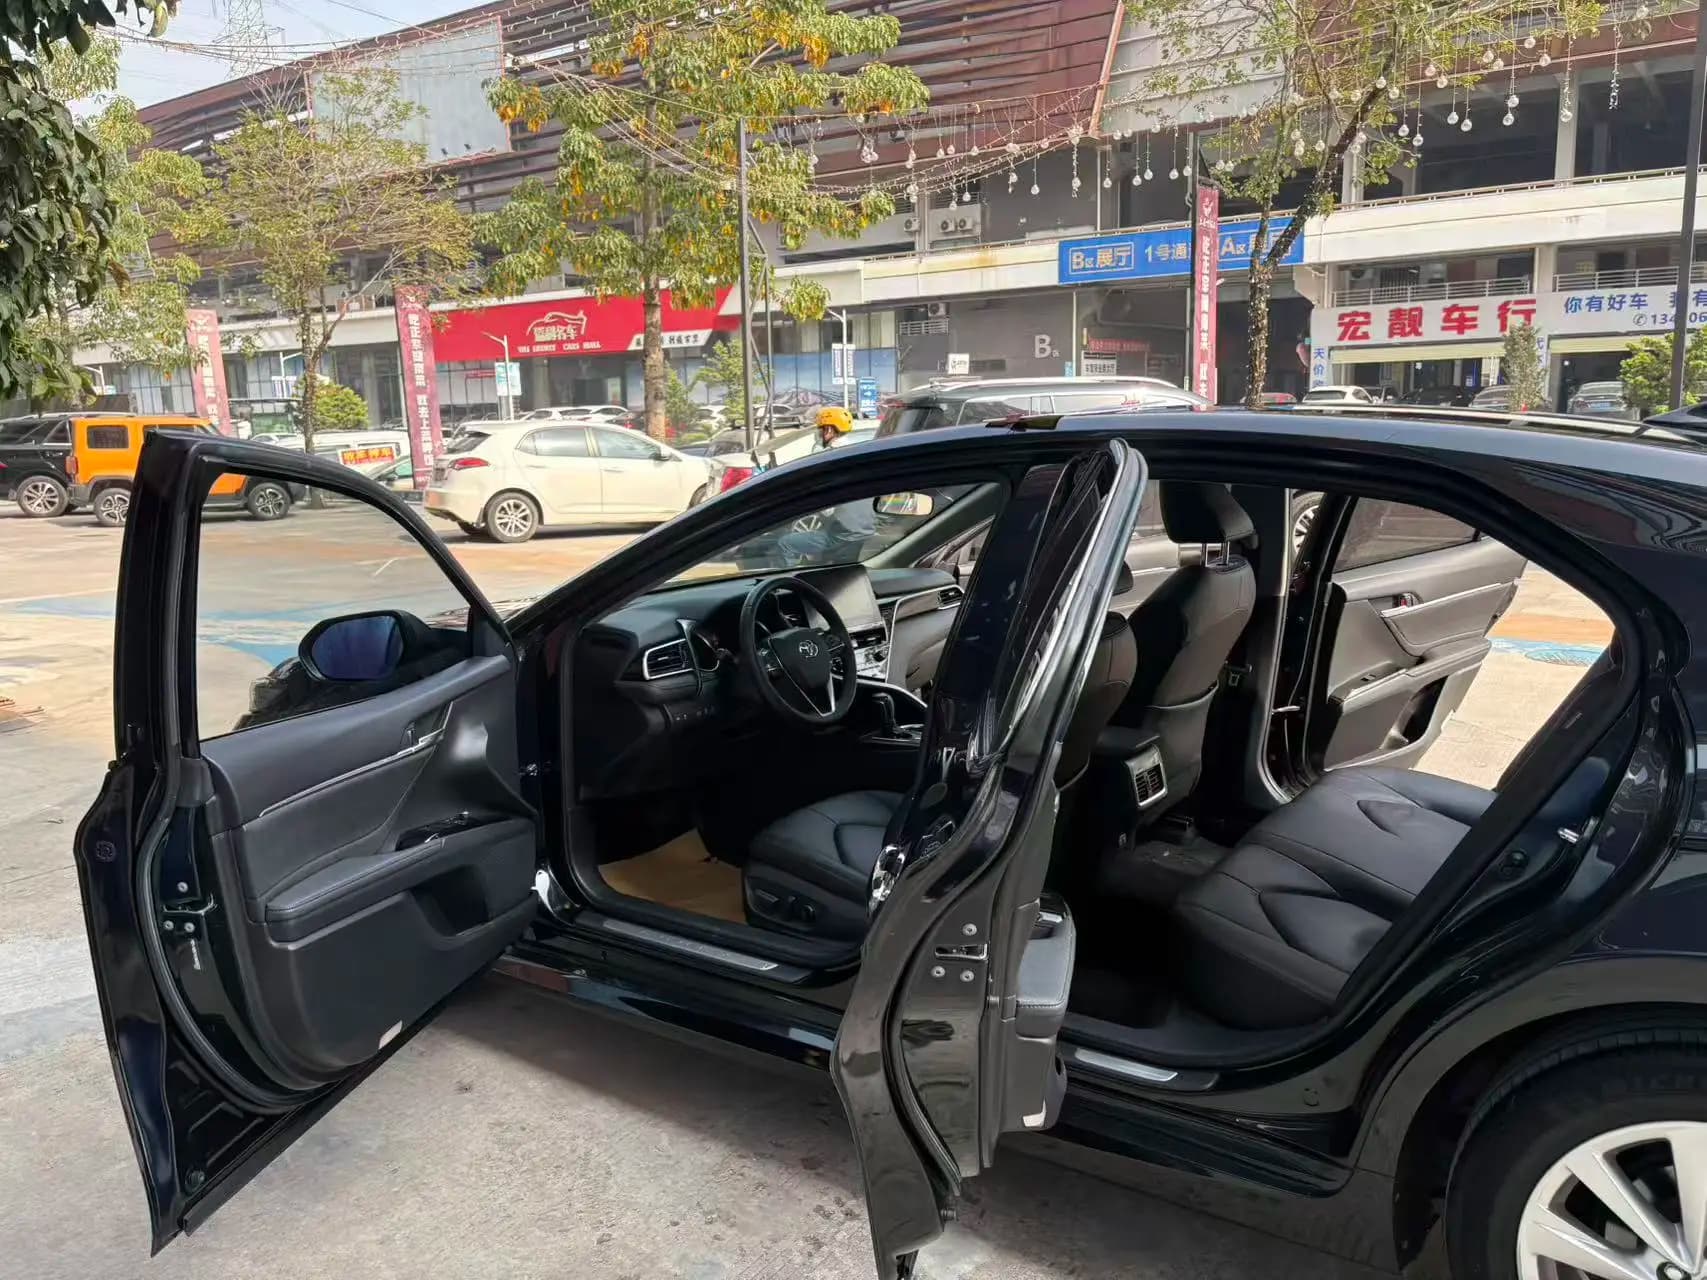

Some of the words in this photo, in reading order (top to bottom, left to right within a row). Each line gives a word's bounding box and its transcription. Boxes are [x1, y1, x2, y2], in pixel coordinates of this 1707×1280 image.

[1071, 246, 1131, 270] B区展厅
[1145, 243, 1192, 262] 1号通
[1564, 293, 1648, 314] 你有好车
[1337, 298, 1537, 341] 宏靓车行
[1651, 312, 1707, 325] 13406
